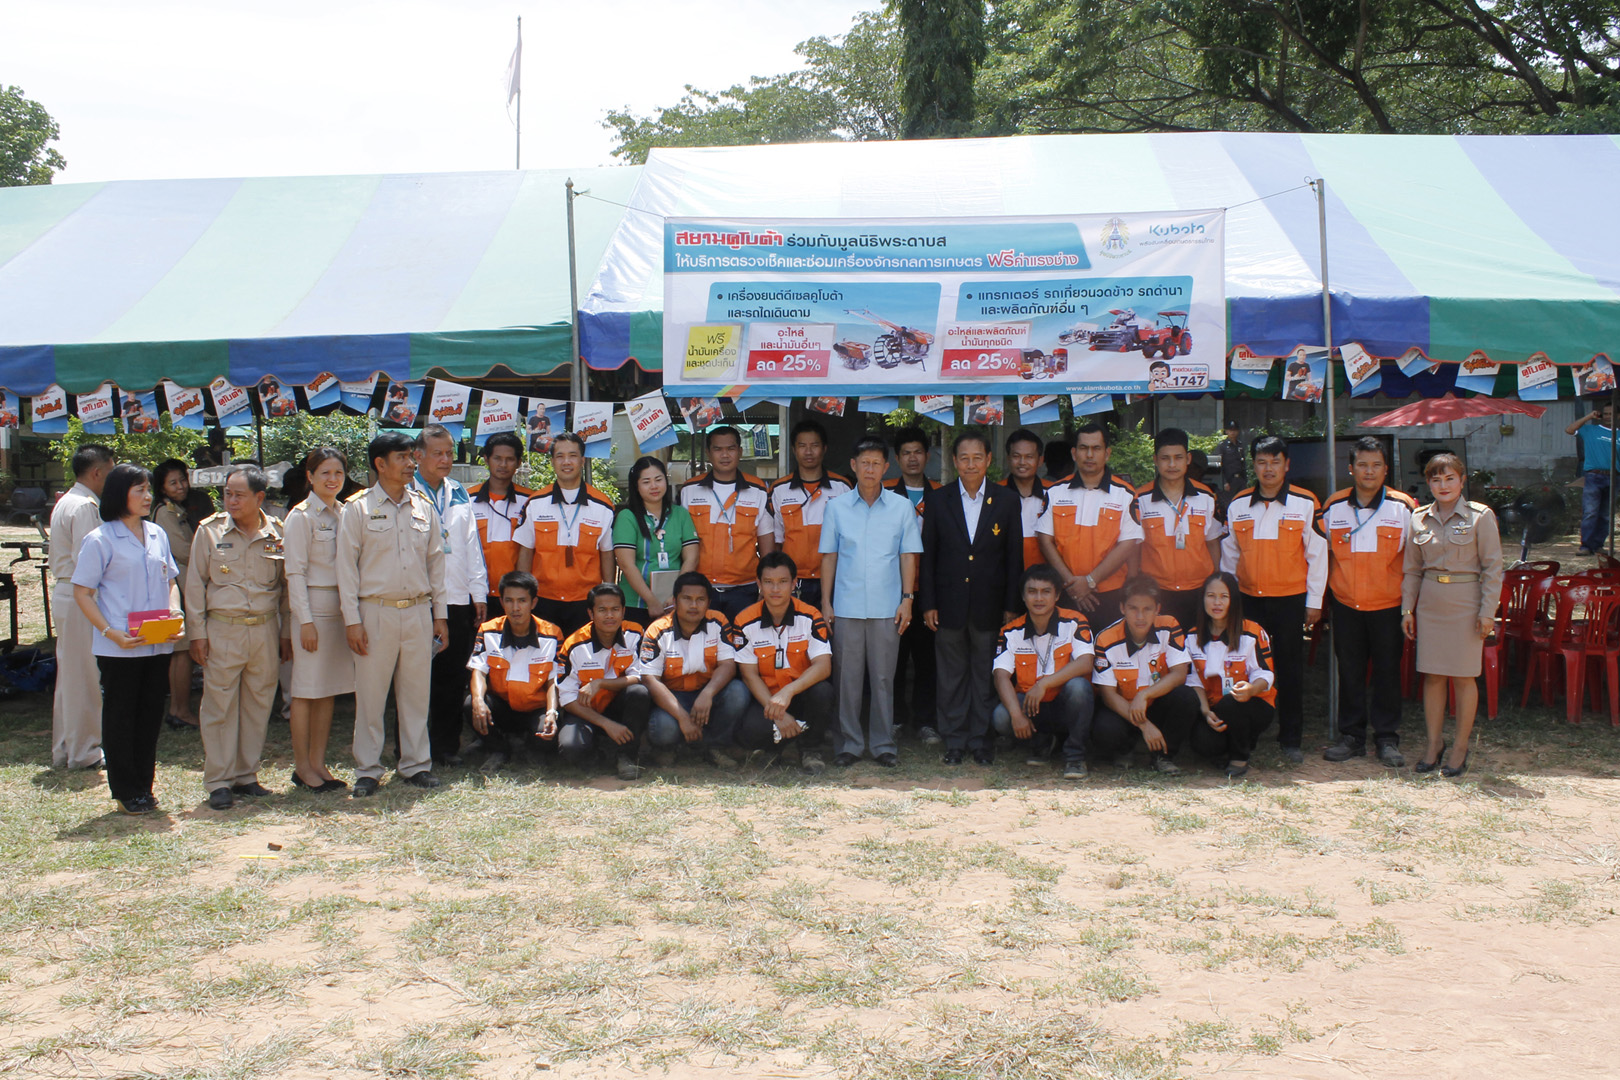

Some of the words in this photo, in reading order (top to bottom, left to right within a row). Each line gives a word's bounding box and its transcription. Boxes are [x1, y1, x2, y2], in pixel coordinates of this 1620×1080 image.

[1149, 223, 1205, 236] Kubota
[676, 230, 783, 249] สยามคูโบต้า
[787, 233, 947, 251] ร่วมกับมูลนิธิพระดาบส
[675, 253, 982, 267] ให้บริการตรวจเช็คและซ่อมเครื่องจักรกลการเกษตร
[987, 249, 1079, 267] ฟรีค่าแรงช่าง
[727, 288, 843, 303] เครื่องยนต์ดีเซลคูโบต้า
[978, 288, 1039, 300] แทรกเตอร์
[1044, 284, 1134, 298] รถเกี่ยวนวดข้าว
[1138, 285, 1183, 297] รถดำนา
[727, 306, 811, 318] และรถไถเดินตาม
[981, 300, 1076, 315] และผลิตภัณฑ์อื่น
[777, 326, 804, 337] อะไหล่
[948, 326, 1027, 336] อะไหล่และผลิตภัณฑ์
[707, 332, 726, 344] ฟรี
[961, 336, 1013, 348] น้ำมันทุกชนิด
[688, 345, 736, 356] น้ำมันเครื่อง
[756, 360, 776, 371] ลด
[782, 354, 821, 372] 25%
[950, 359, 971, 370] ลด
[977, 353, 1017, 370] 25%
[1172, 375, 1206, 386] 1747
[1066, 384, 1141, 392] www.siamkubota.co.th
[483, 411, 512, 425] คูโบต้า
[637, 409, 664, 431] คูโบต้า
